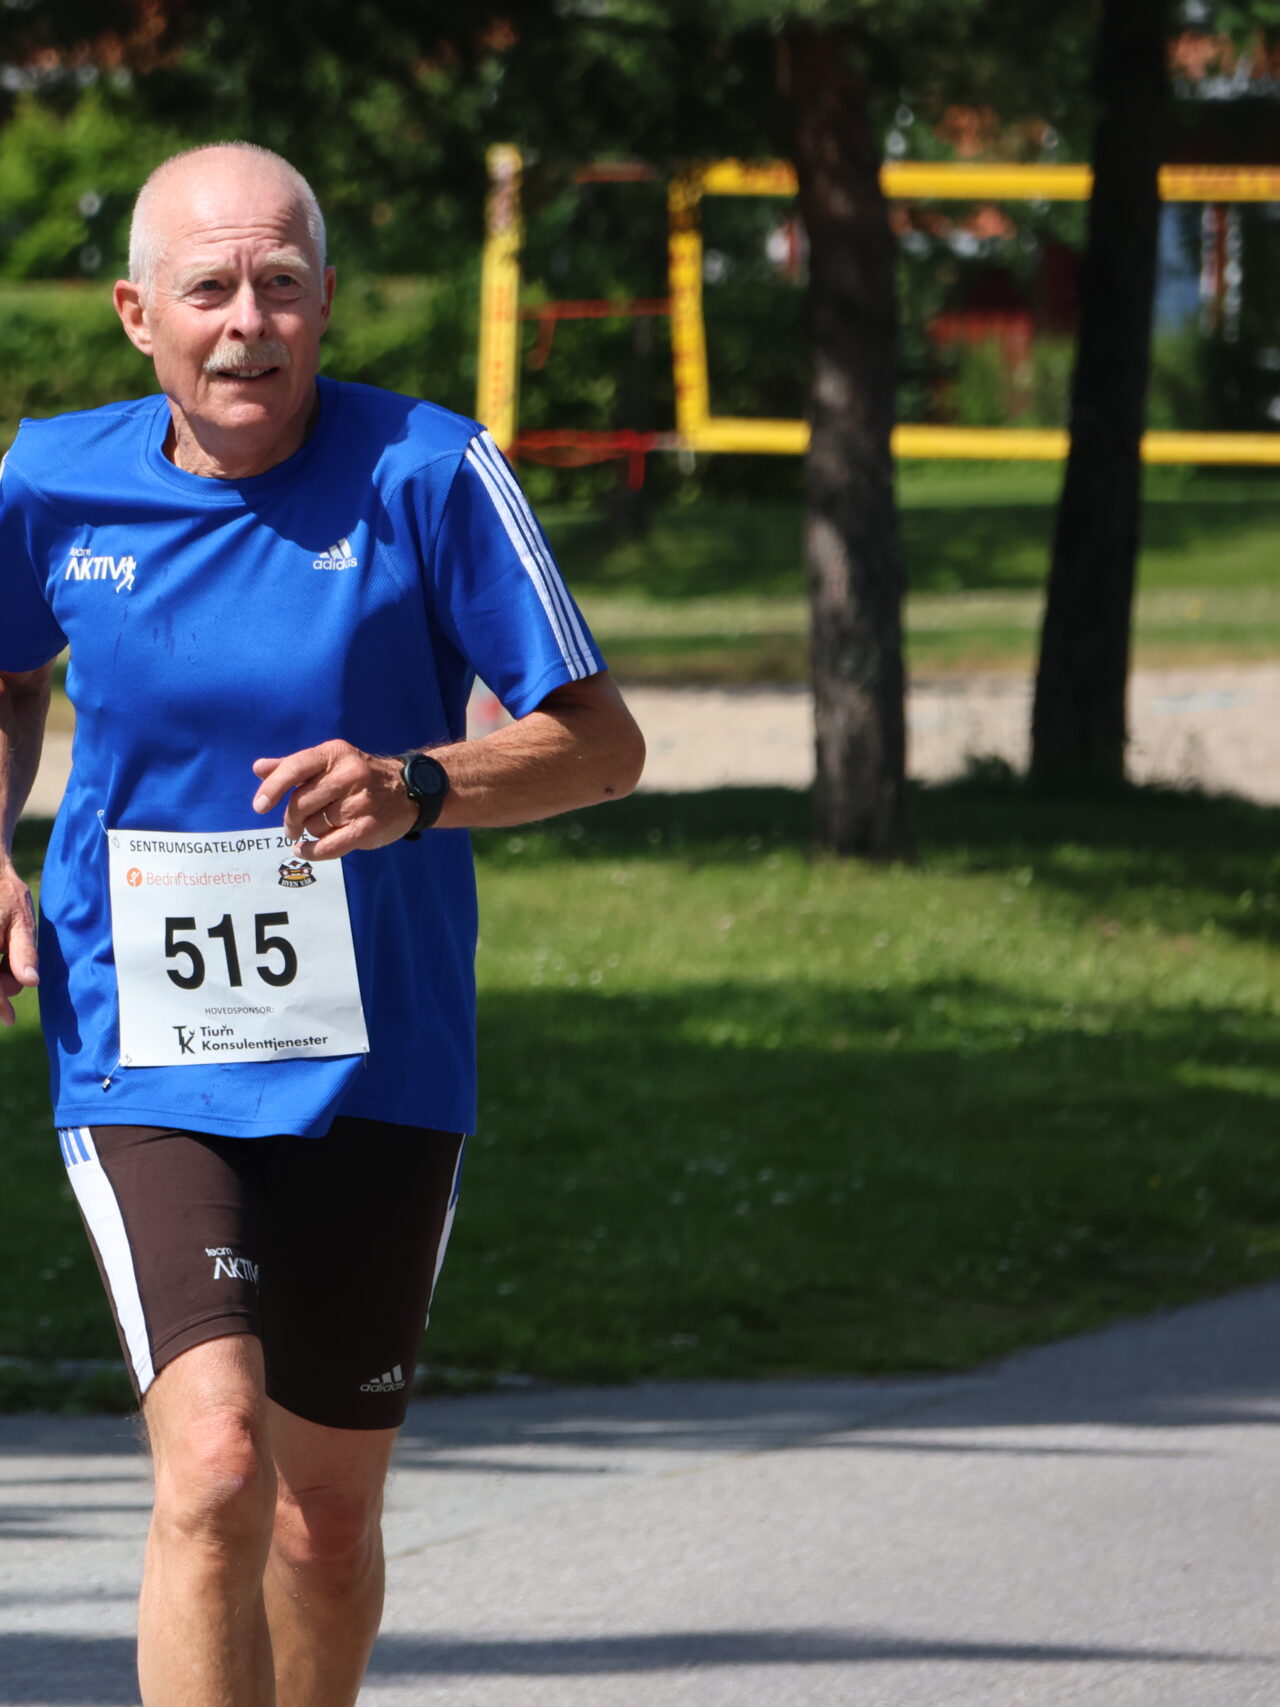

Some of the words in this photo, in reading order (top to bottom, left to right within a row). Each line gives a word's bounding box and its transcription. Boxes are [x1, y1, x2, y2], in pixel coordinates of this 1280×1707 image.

[65, 556, 127, 580] AKTIV
[312, 557, 358, 570] adidas
[129, 837, 272, 854] SENTRUMSGATELØPET
[146, 871, 251, 886] Bedriftsidretten
[165, 911, 298, 990] 515
[204, 1006, 275, 1015] HOVEDSPONSOR:
[201, 1036, 329, 1051] Konsulenttjenester
[205, 1247, 233, 1257] team
[359, 1380, 406, 1393] adidas
